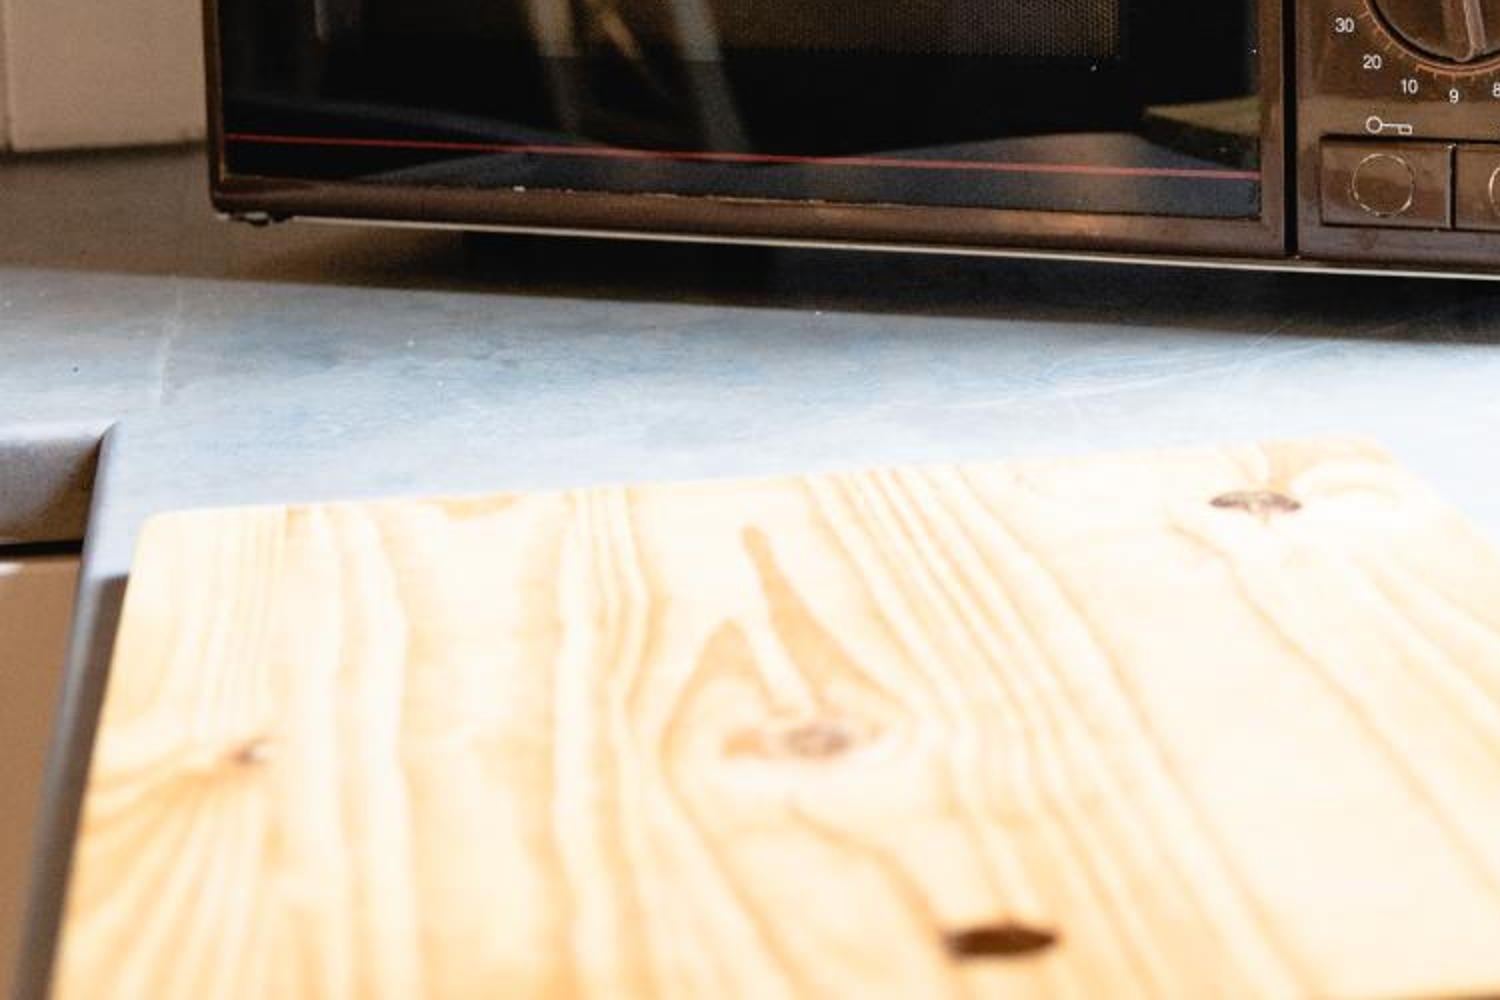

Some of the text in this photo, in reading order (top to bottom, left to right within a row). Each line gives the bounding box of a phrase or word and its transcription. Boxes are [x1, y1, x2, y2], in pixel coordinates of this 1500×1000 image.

[1335, 18, 1355, 32] 30
[1363, 55, 1382, 69] 20
[1401, 79, 1418, 93] 10
[1449, 89, 1459, 104] 9
